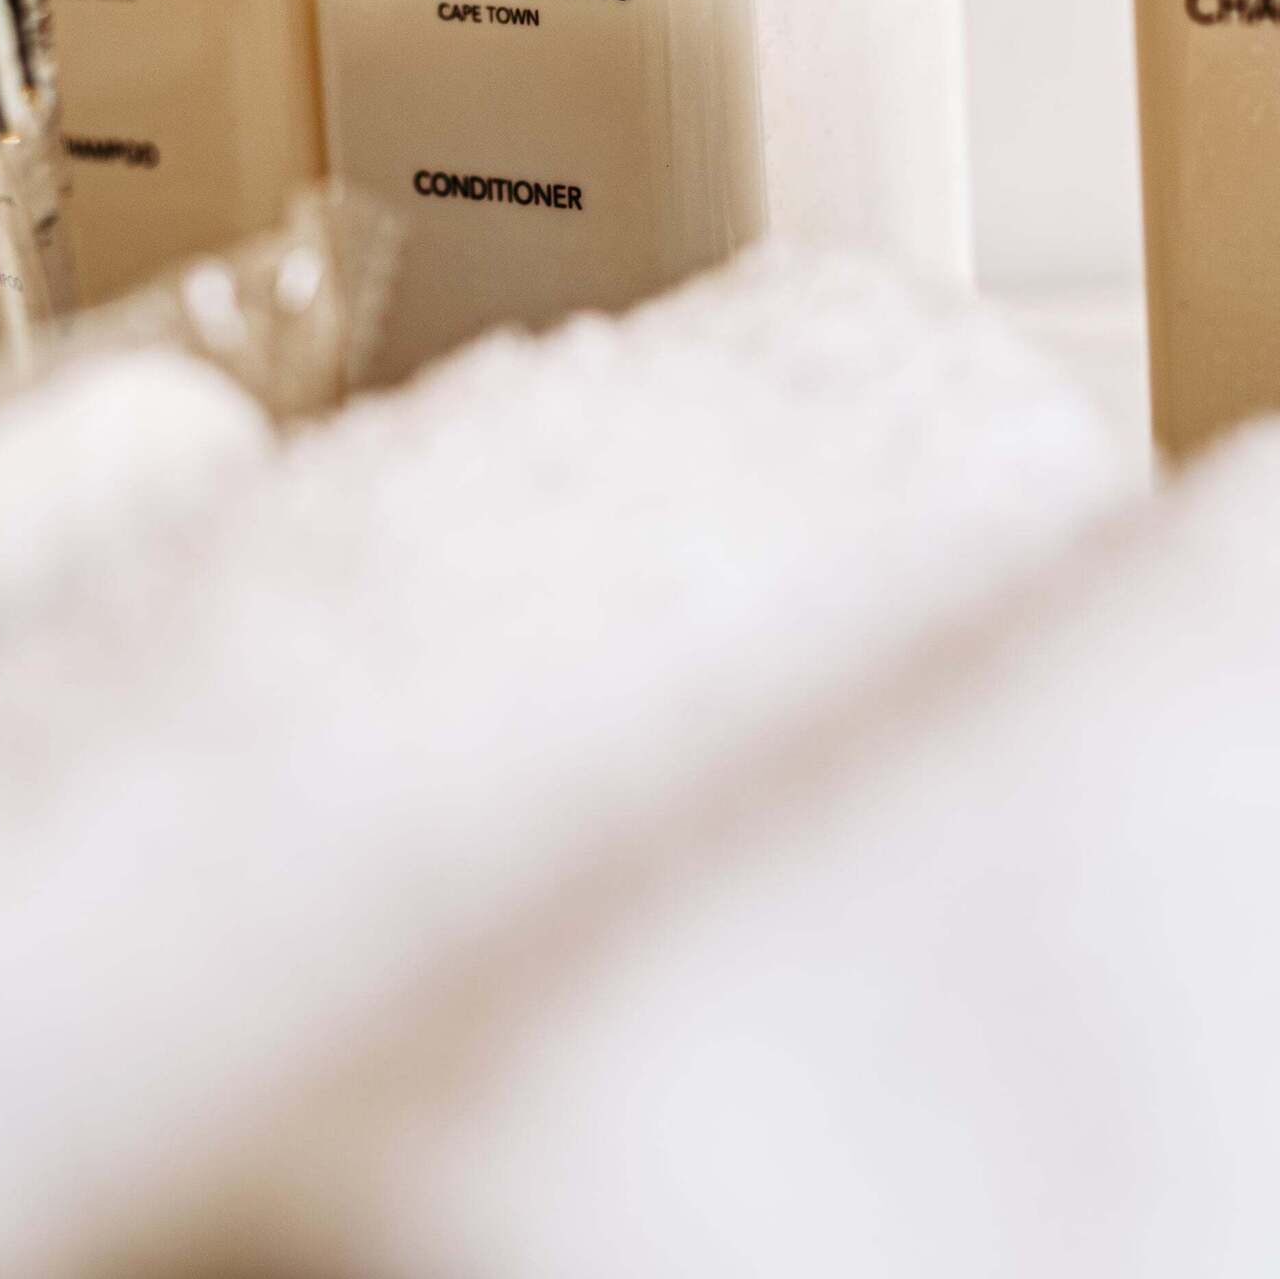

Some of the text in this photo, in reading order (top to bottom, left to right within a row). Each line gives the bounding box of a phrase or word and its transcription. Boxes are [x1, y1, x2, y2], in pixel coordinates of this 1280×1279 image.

[438, 2, 539, 26] CAPE TOWN
[414, 170, 583, 210] CONDITIONER
